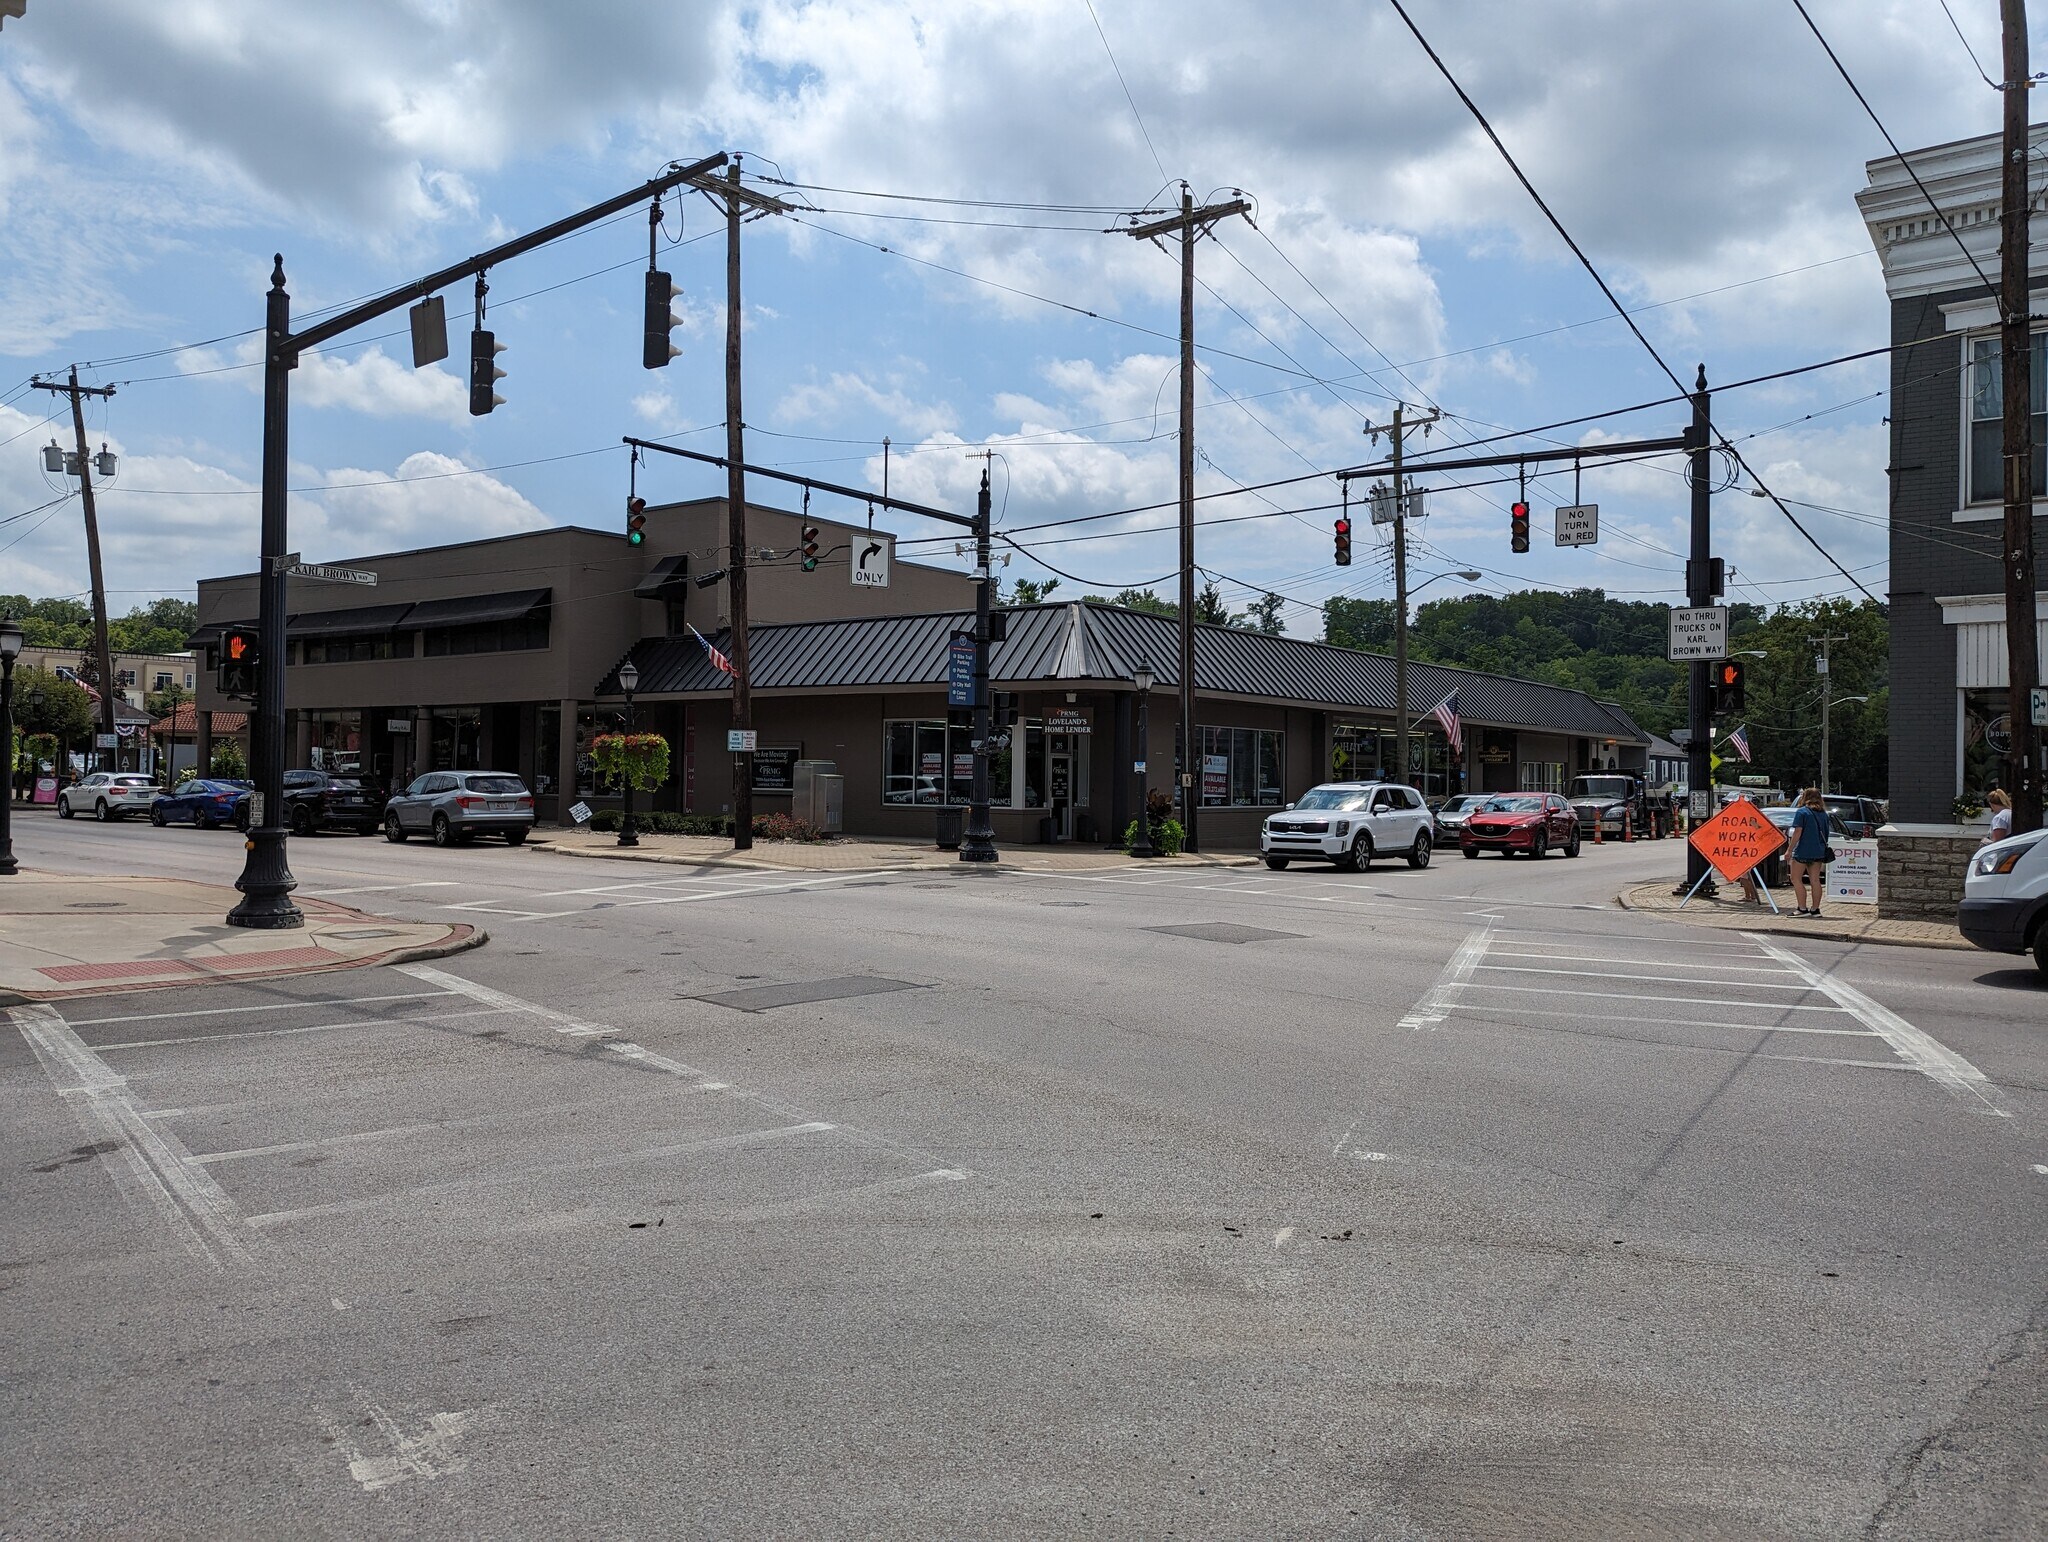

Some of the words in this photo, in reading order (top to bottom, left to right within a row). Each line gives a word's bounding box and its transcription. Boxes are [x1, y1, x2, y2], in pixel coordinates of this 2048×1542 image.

[1568, 510, 1584, 519] NO
[1564, 520, 1589, 530] TURN
[1558, 533, 1571, 541] ON
[1576, 531, 1594, 540] RED
[295, 565, 321, 576] KARL
[323, 567, 357, 581] BROWN
[855, 571, 884, 584] ONLY
[1679, 613, 1691, 621] NO
[1694, 611, 1716, 621] THRU
[1674, 623, 1706, 633] TRUCKS
[1709, 622, 1721, 631] ON
[1687, 634, 1708, 643] KARL
[1673, 646, 1701, 655] BROWN
[1704, 645, 1722, 654] WAY
[1048, 717, 1088, 725] LOVELAND'S
[1044, 725, 1065, 733] HOME
[1065, 725, 1092, 733] LENDER
[769, 751, 789, 760] Moving!
[762, 767, 781, 775] PRMG
[1205, 774, 1226, 783] AVAILABLE
[1721, 816, 1758, 827] ROAD
[1718, 831, 1756, 842] WORK
[1712, 846, 1759, 858] AHEAD
[1833, 848, 1872, 858] OPEN
